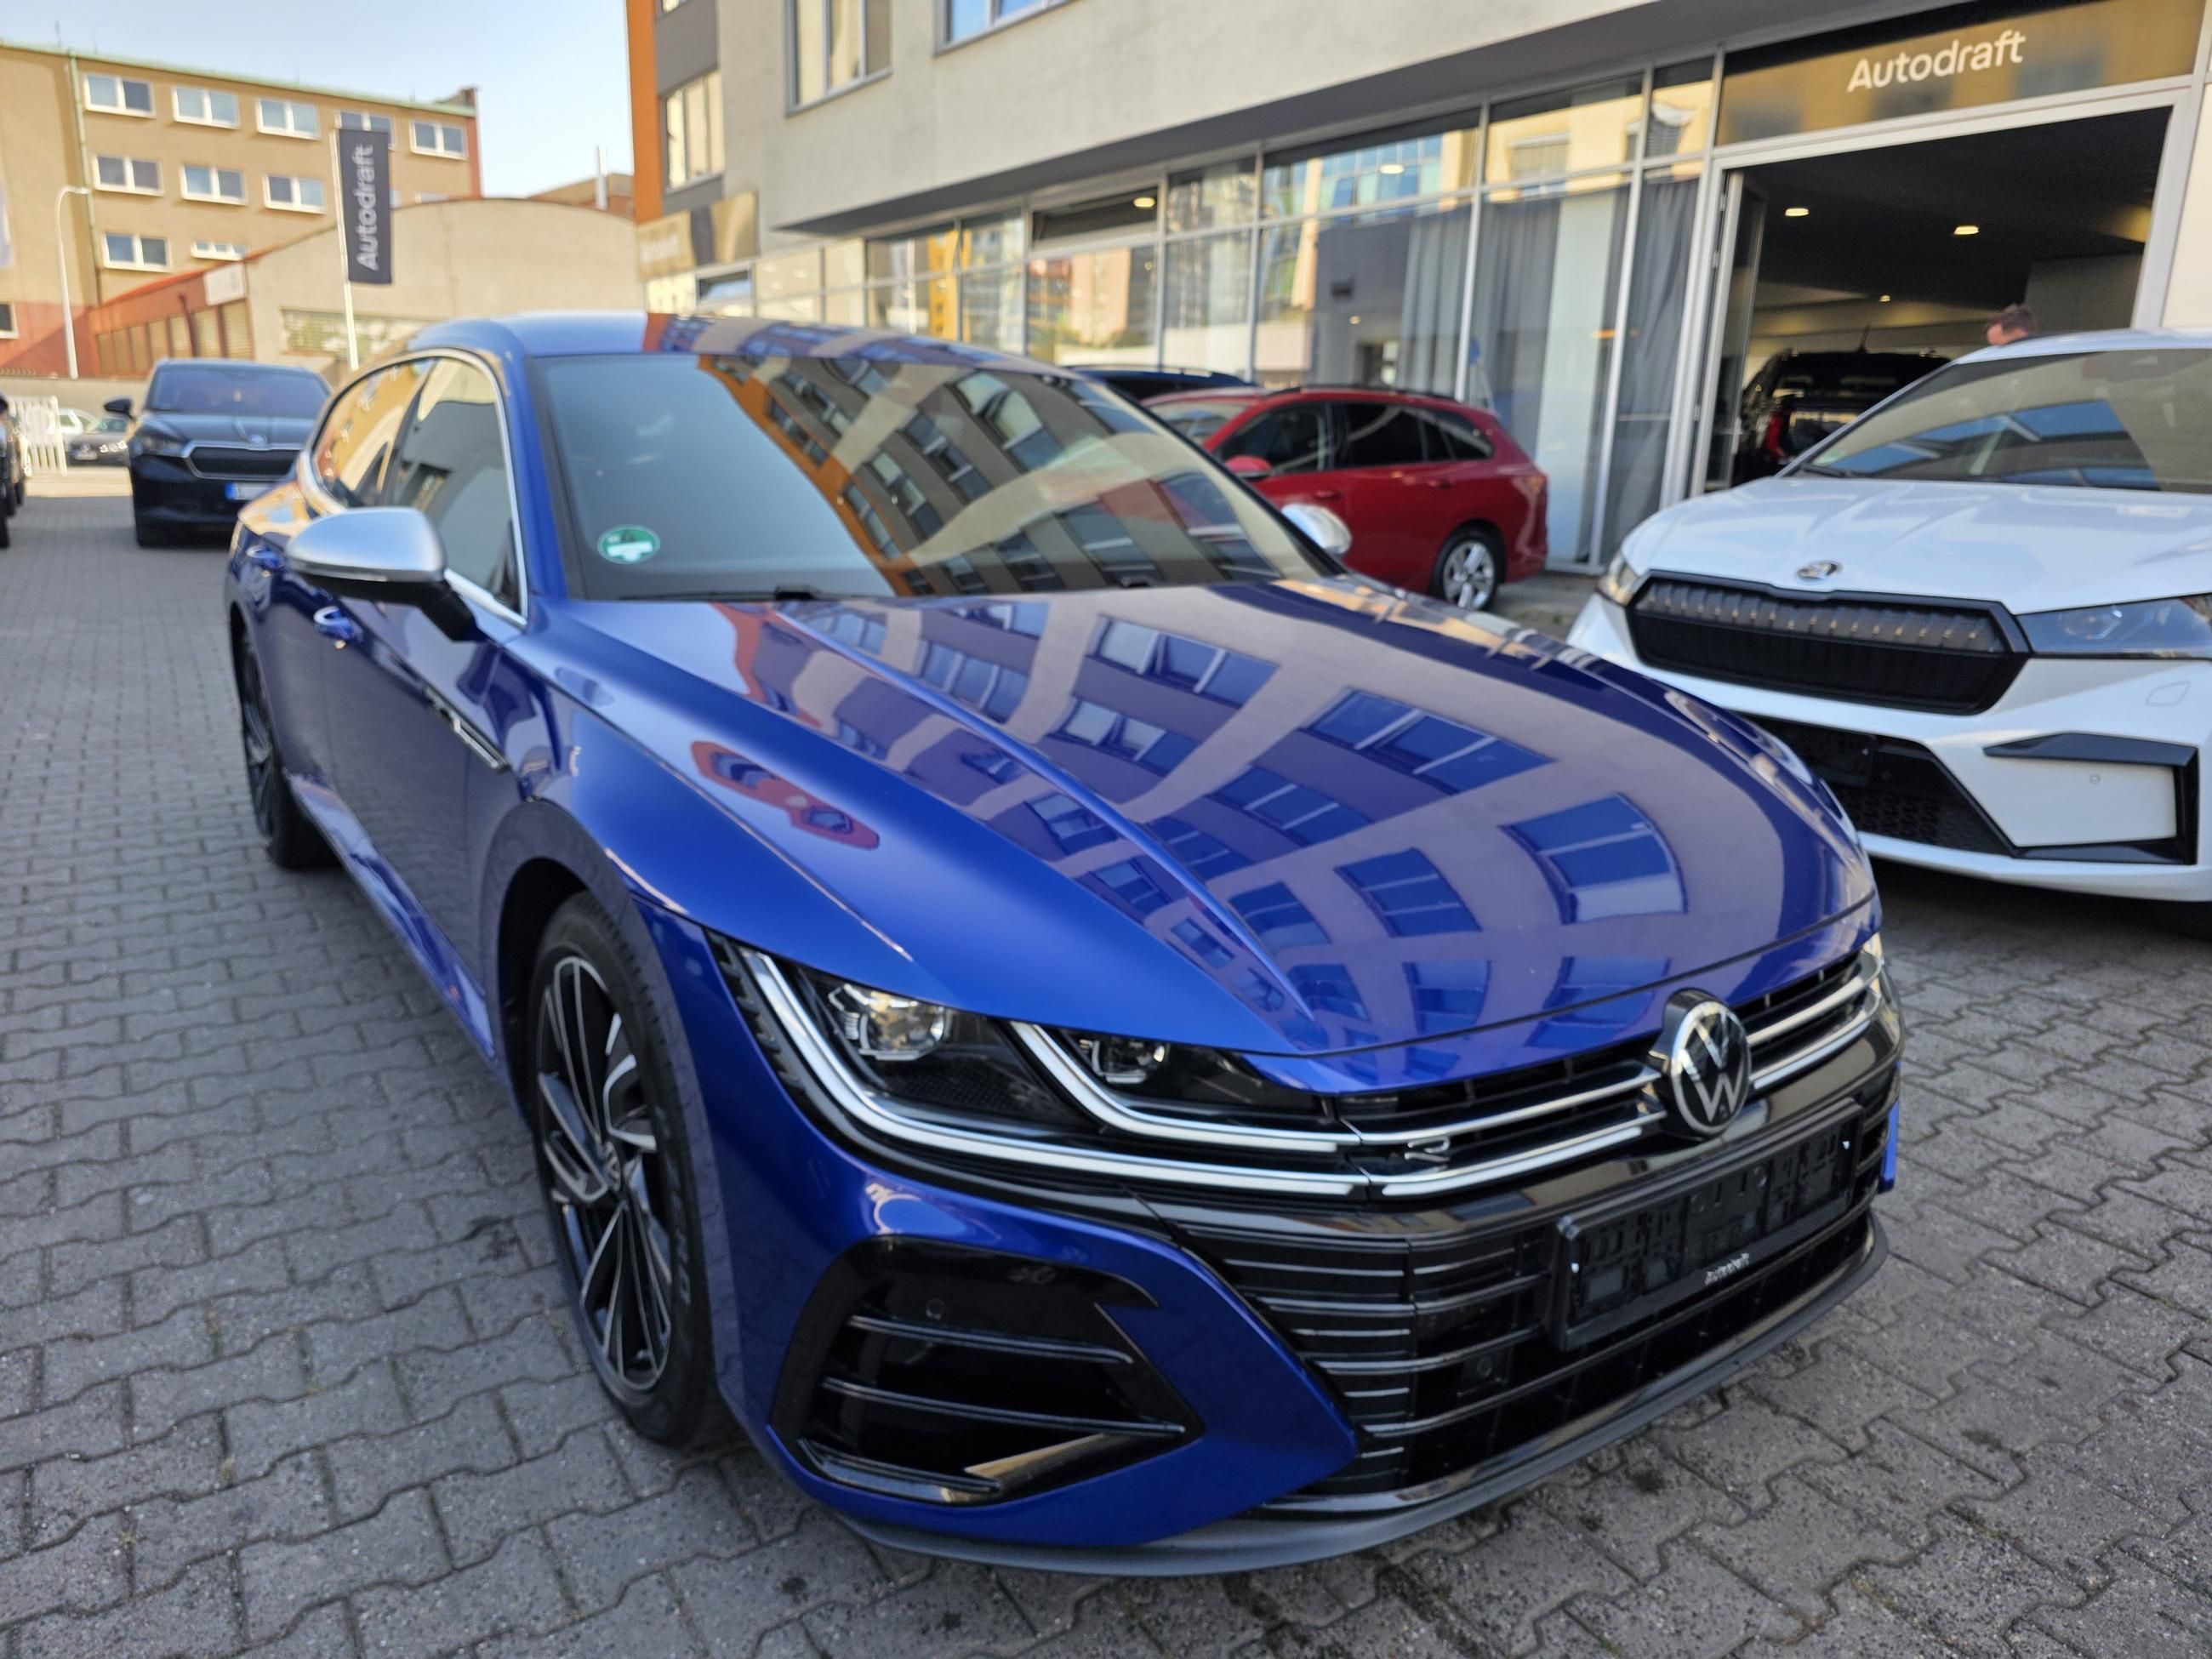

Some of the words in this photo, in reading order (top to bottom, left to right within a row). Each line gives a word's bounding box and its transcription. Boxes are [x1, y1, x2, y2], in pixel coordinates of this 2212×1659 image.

[1846, 30, 2026, 93] Autodraft
[351, 143, 379, 271] Autodraft
[1673, 1004, 1750, 1132] VW
